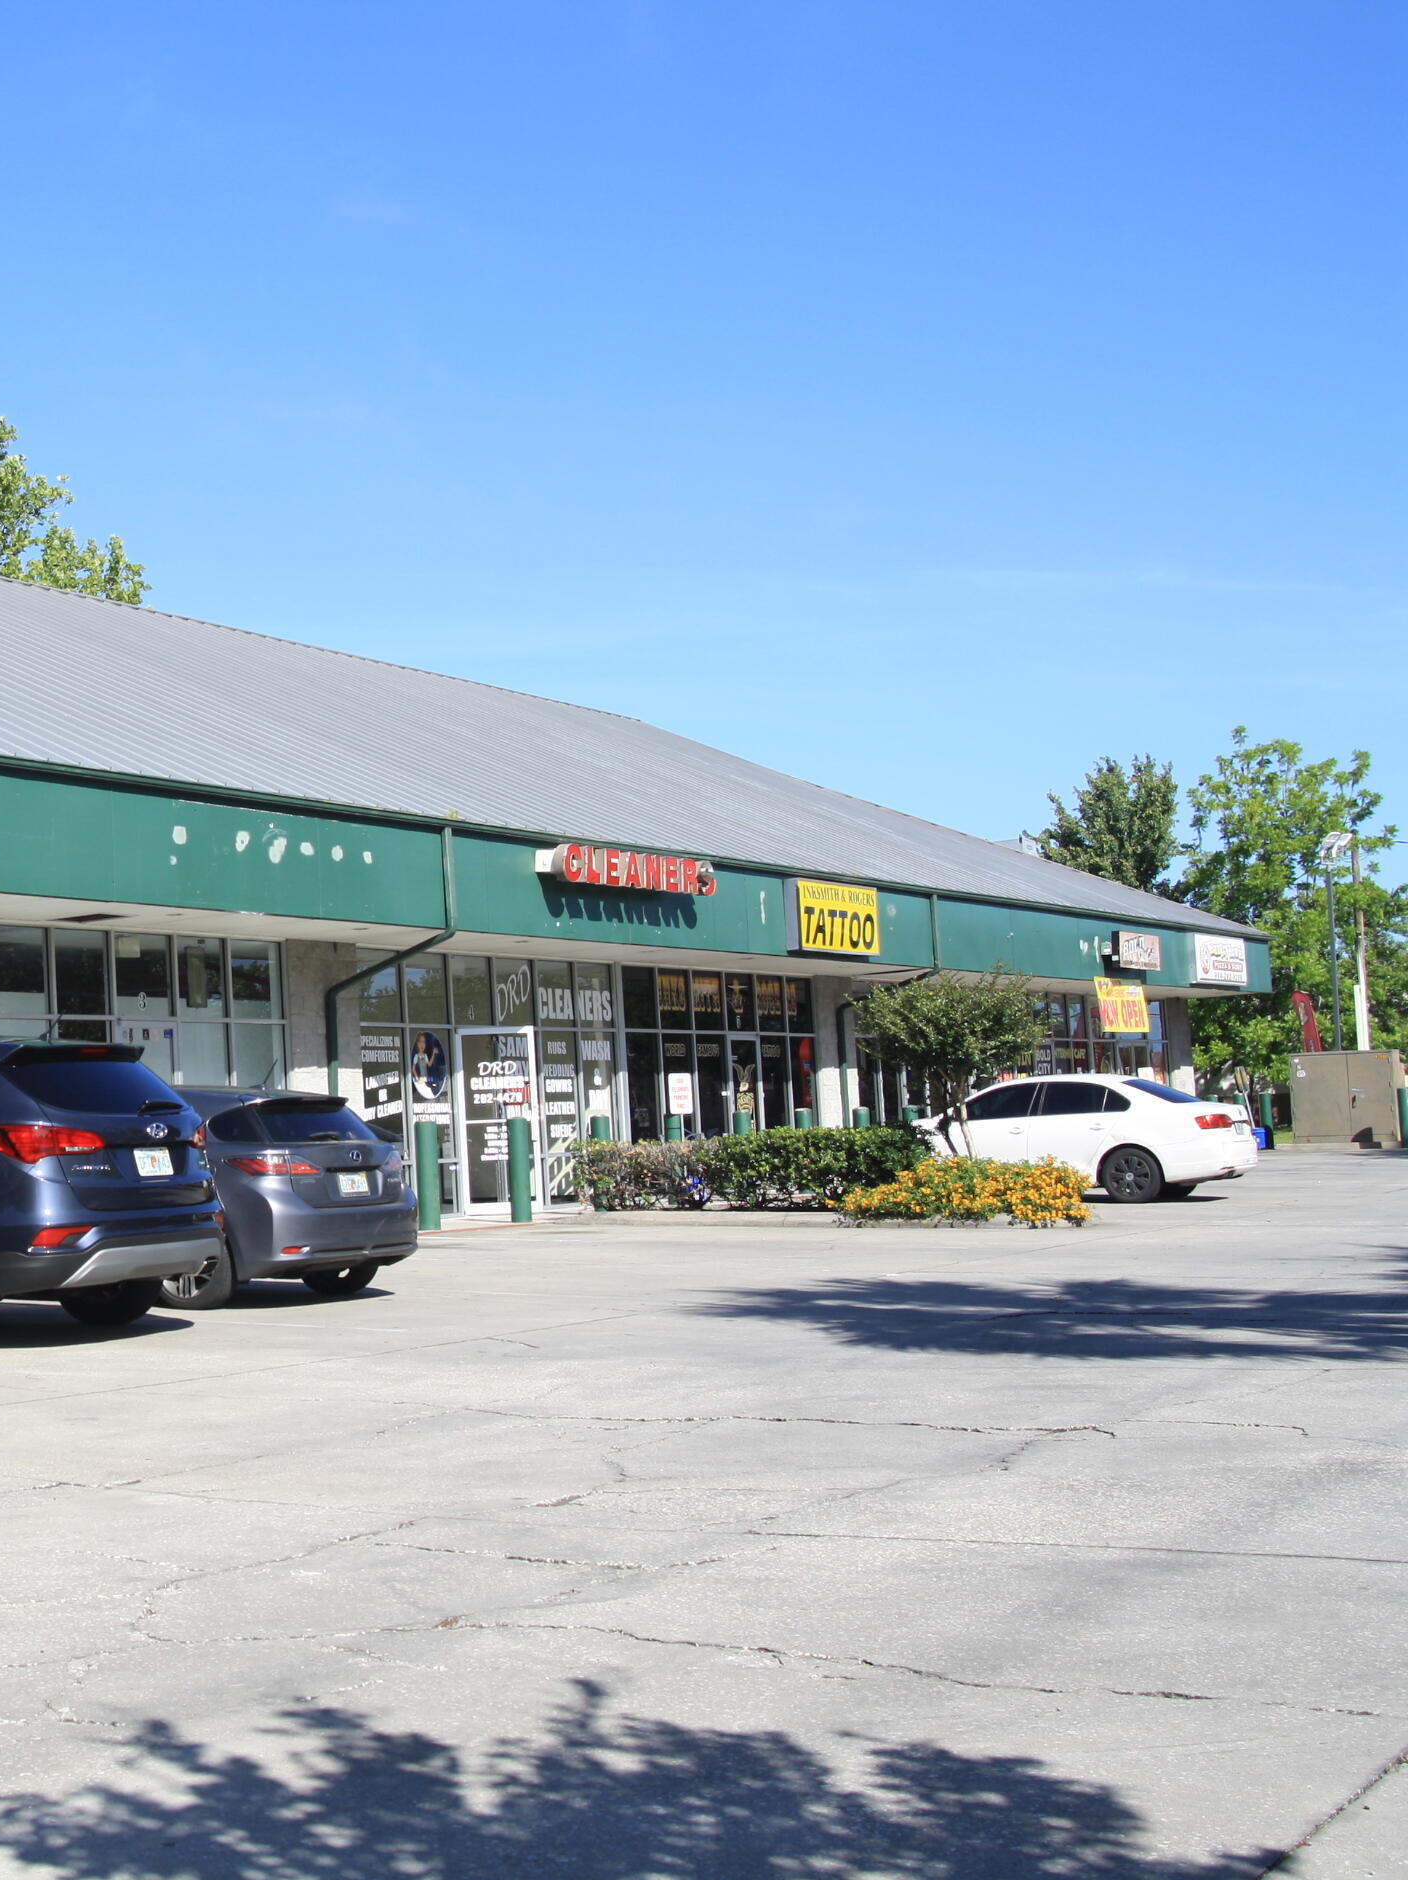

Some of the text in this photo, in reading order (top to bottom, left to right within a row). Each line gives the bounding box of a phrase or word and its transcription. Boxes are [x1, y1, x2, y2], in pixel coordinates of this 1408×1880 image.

[804, 906, 875, 950] TATTOO
[496, 964, 531, 1022] DRD
[137, 991, 148, 1011] 3
[547, 1041, 567, 1055] RUGS
[580, 1040, 611, 1061] WASH
[361, 1049, 399, 1063] COMFORTERS
[478, 1061, 517, 1076] DRD
[470, 1076, 524, 1091] CLEANERS
[545, 1079, 573, 1093] GOWNS
[413, 1103, 452, 1114] ROFESSIONAL
[545, 1101, 576, 1116] LEATHER
[550, 1124, 573, 1138] SUEDE
